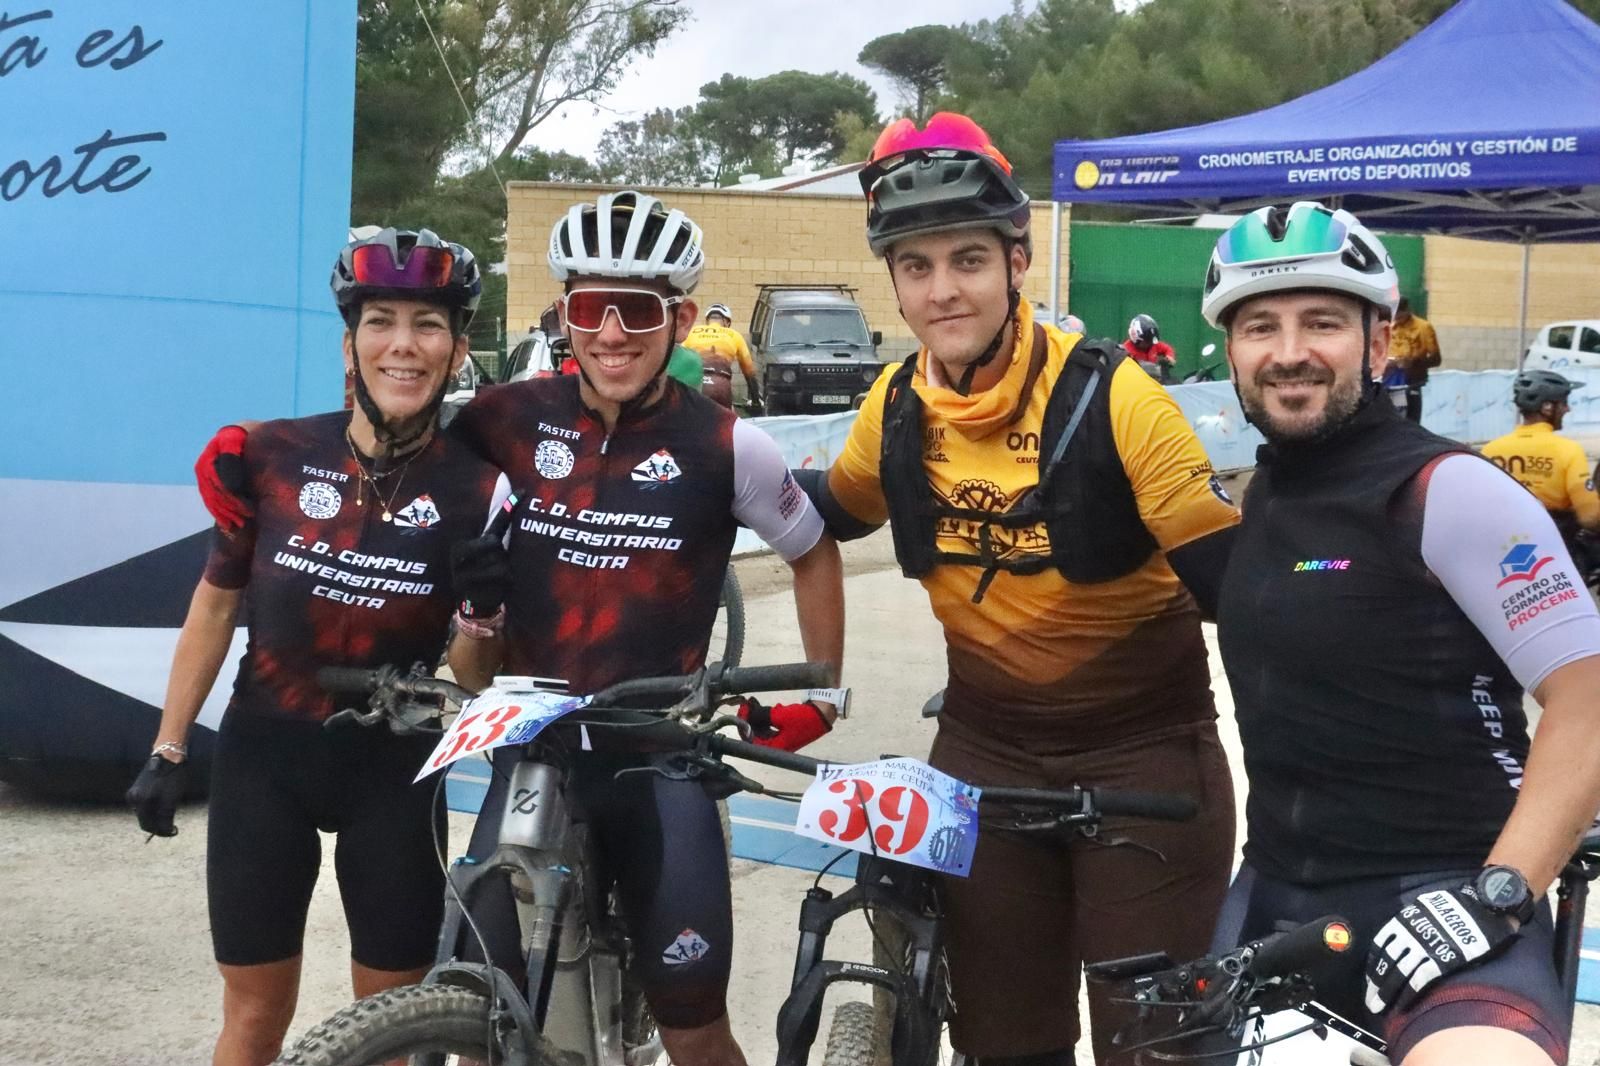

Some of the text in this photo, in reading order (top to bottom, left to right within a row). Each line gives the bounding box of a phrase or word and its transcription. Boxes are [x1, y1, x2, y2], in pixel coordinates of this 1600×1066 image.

[76, 25, 163, 70] es
[1199, 148, 1324, 169] CRONOMETRAJE
[1328, 139, 1452, 162] ORGANIZACIÓN
[1456, 141, 1468, 156] Y
[1471, 136, 1547, 156] GESTIÓN
[1552, 137, 1577, 152] DE
[1288, 162, 1471, 183] EVENTOS DEPORTIVOS
[681, 241, 698, 269] SCOTT
[1251, 266, 1299, 277] OAKLEY
[538, 422, 581, 440] FASTER
[1006, 432, 1039, 451] on
[303, 465, 349, 483] FASTER
[529, 498, 673, 529] C. D. CAMPUS
[520, 518, 683, 551] UNIVERSITARIO
[287, 535, 428, 575] C. D. CAMPUS
[558, 548, 630, 570] CEUTA
[1294, 560, 1351, 571] DAREVIE
[274, 551, 434, 595] UNIVERSITARIO
[312, 585, 387, 610] CEUTA
[1501, 571, 1568, 610] CENTRO DE
[1504, 579, 1573, 621] FORMACIÓN
[1508, 588, 1579, 631] PROCEME
[1472, 674, 1504, 739] KEEP
[433, 705, 523, 768] 53
[883, 770, 897, 780] DE
[901, 773, 935, 794] CEUTA
[884, 762, 936, 784] MARATON
[819, 779, 929, 854] 39
[1430, 893, 1478, 946] MILAGROS
[1412, 916, 1456, 963] JUSTOS
[1375, 958, 1389, 976] 13
